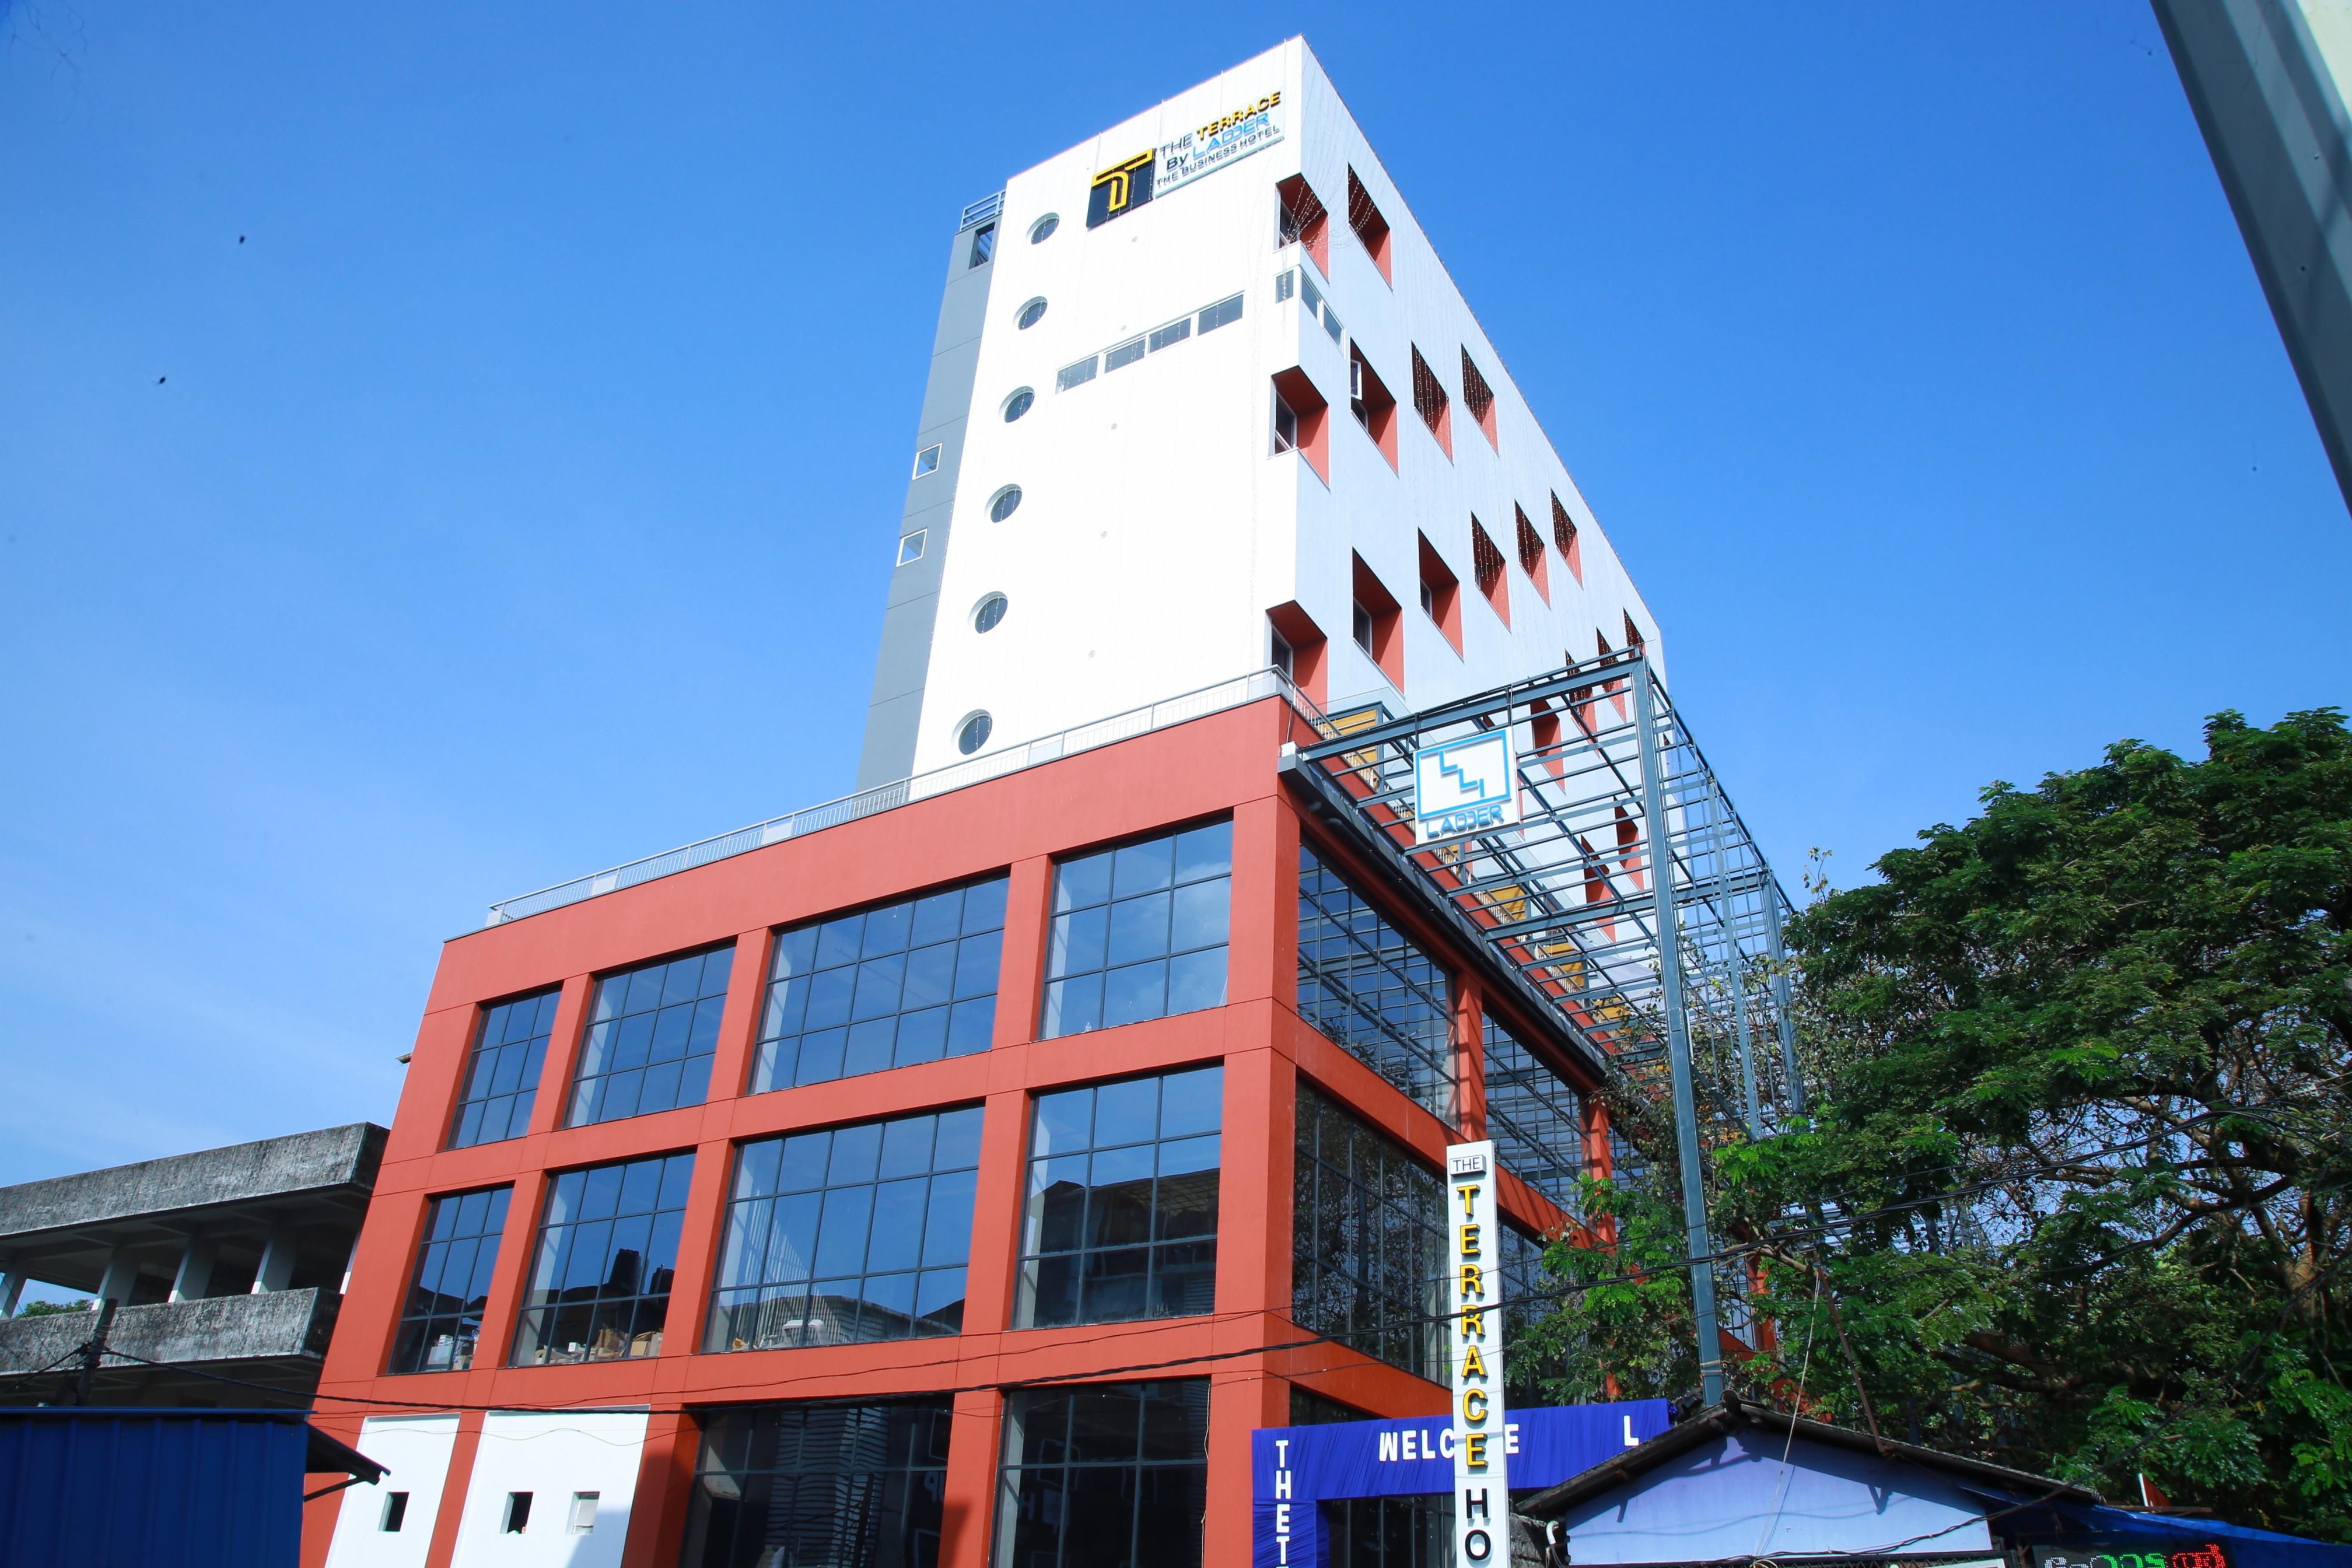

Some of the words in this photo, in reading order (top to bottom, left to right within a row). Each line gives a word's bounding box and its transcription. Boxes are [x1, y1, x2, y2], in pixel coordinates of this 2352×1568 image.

[1160, 133, 1193, 157] THE
[1197, 91, 1280, 141] TERRACE
[1167, 153, 1188, 170] By
[1193, 113, 1269, 160] LADDER
[1157, 171, 1178, 187] THE
[1182, 144, 1237, 174] BUSINESS
[1240, 125, 1280, 148] HOTEL
[1426, 804, 1504, 838] LADDER
[1452, 1157, 1480, 1172] THE
[1457, 1184, 1488, 1467] TERRACE
[1378, 1423, 1520, 1462] WELCE
